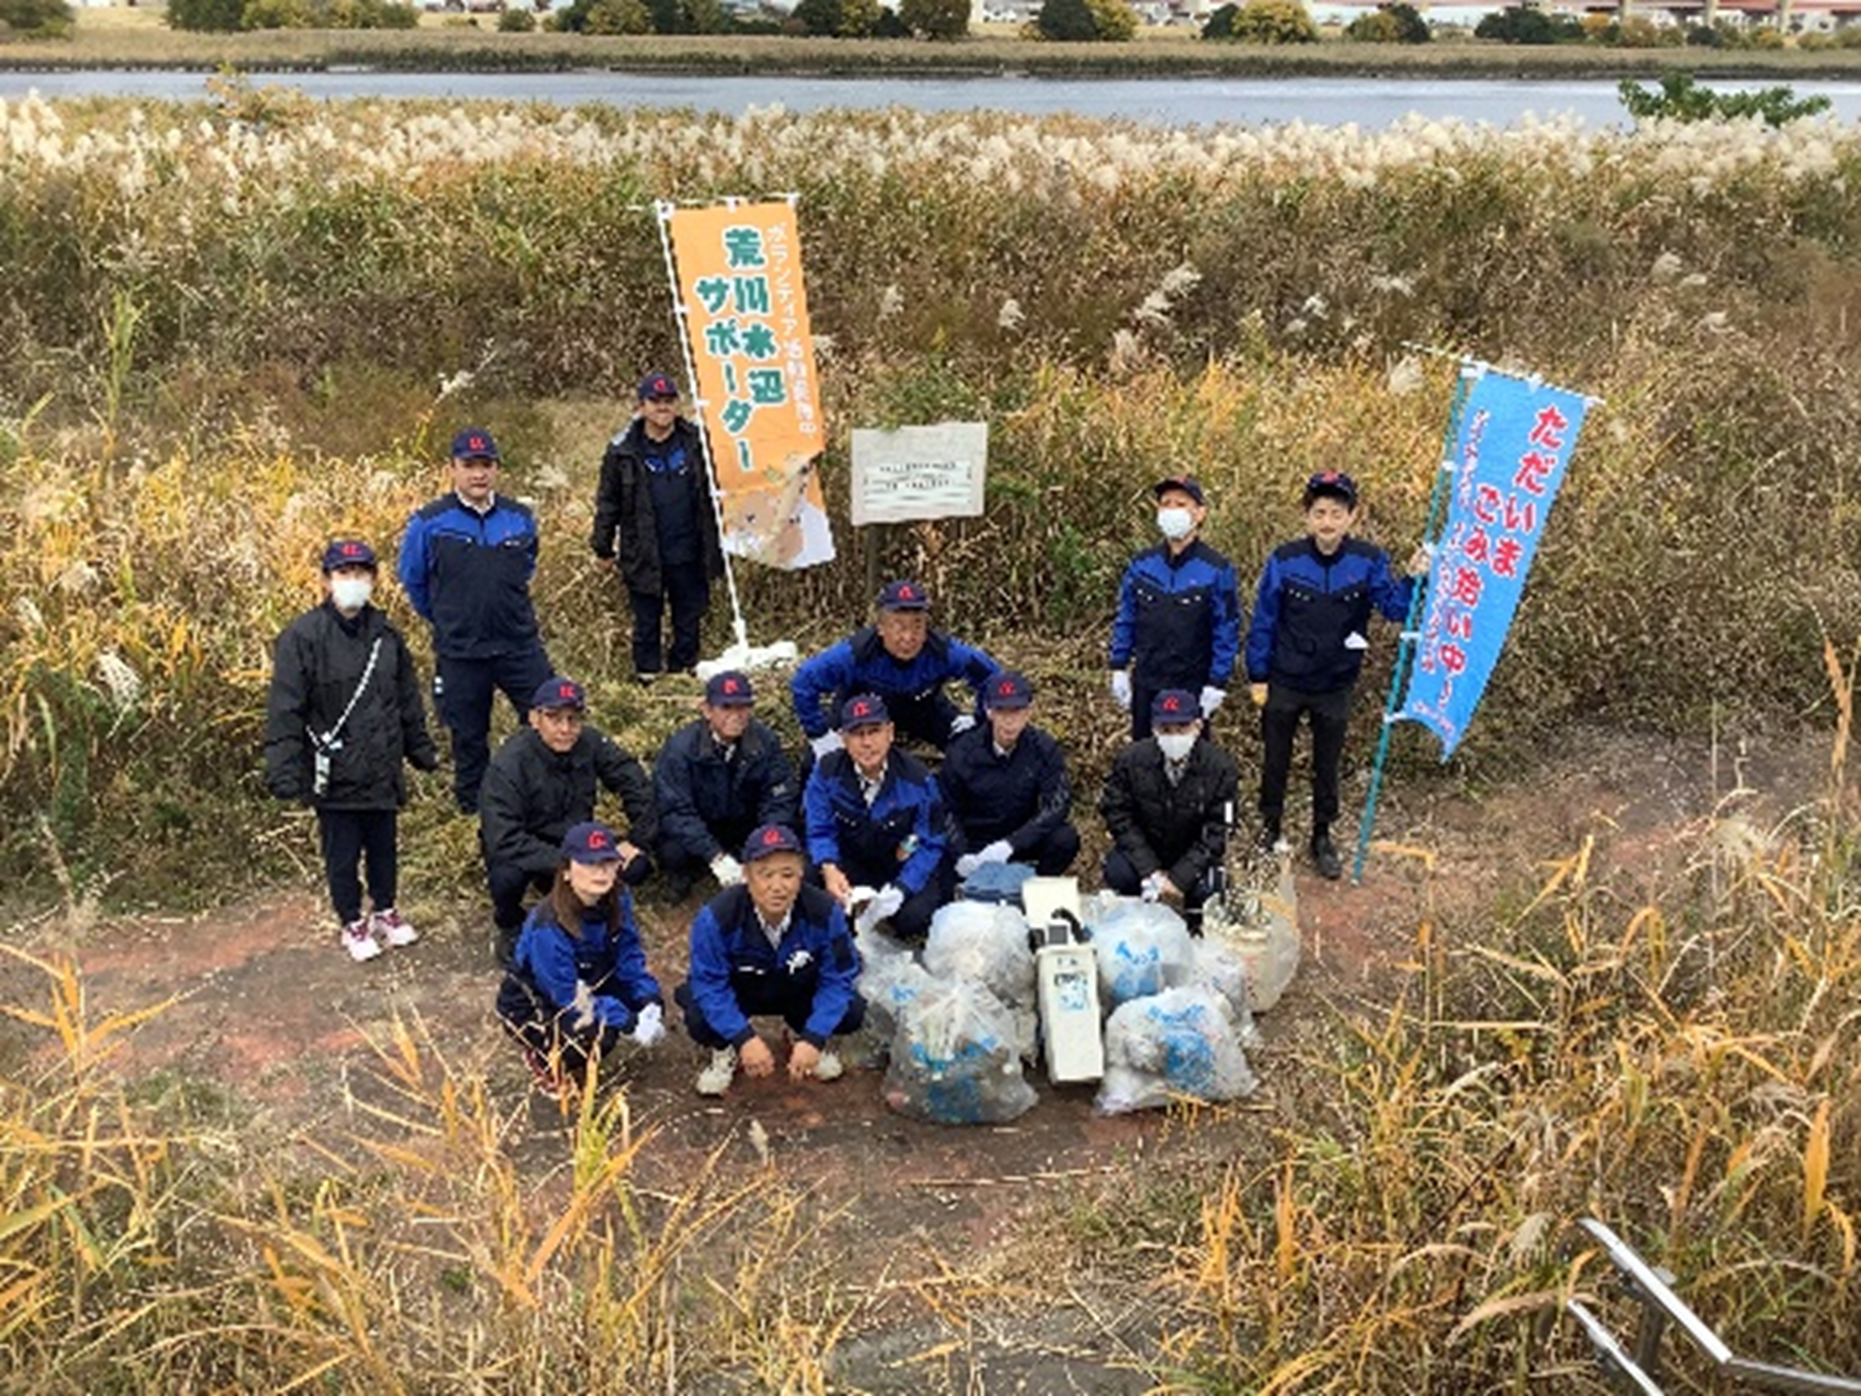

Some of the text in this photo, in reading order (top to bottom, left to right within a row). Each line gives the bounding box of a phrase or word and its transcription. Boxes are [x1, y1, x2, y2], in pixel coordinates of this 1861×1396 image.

[696, 276, 752, 470] サポーター
[724, 227, 786, 404] 荒川水辺
[1491, 404, 1570, 577] ただいま
